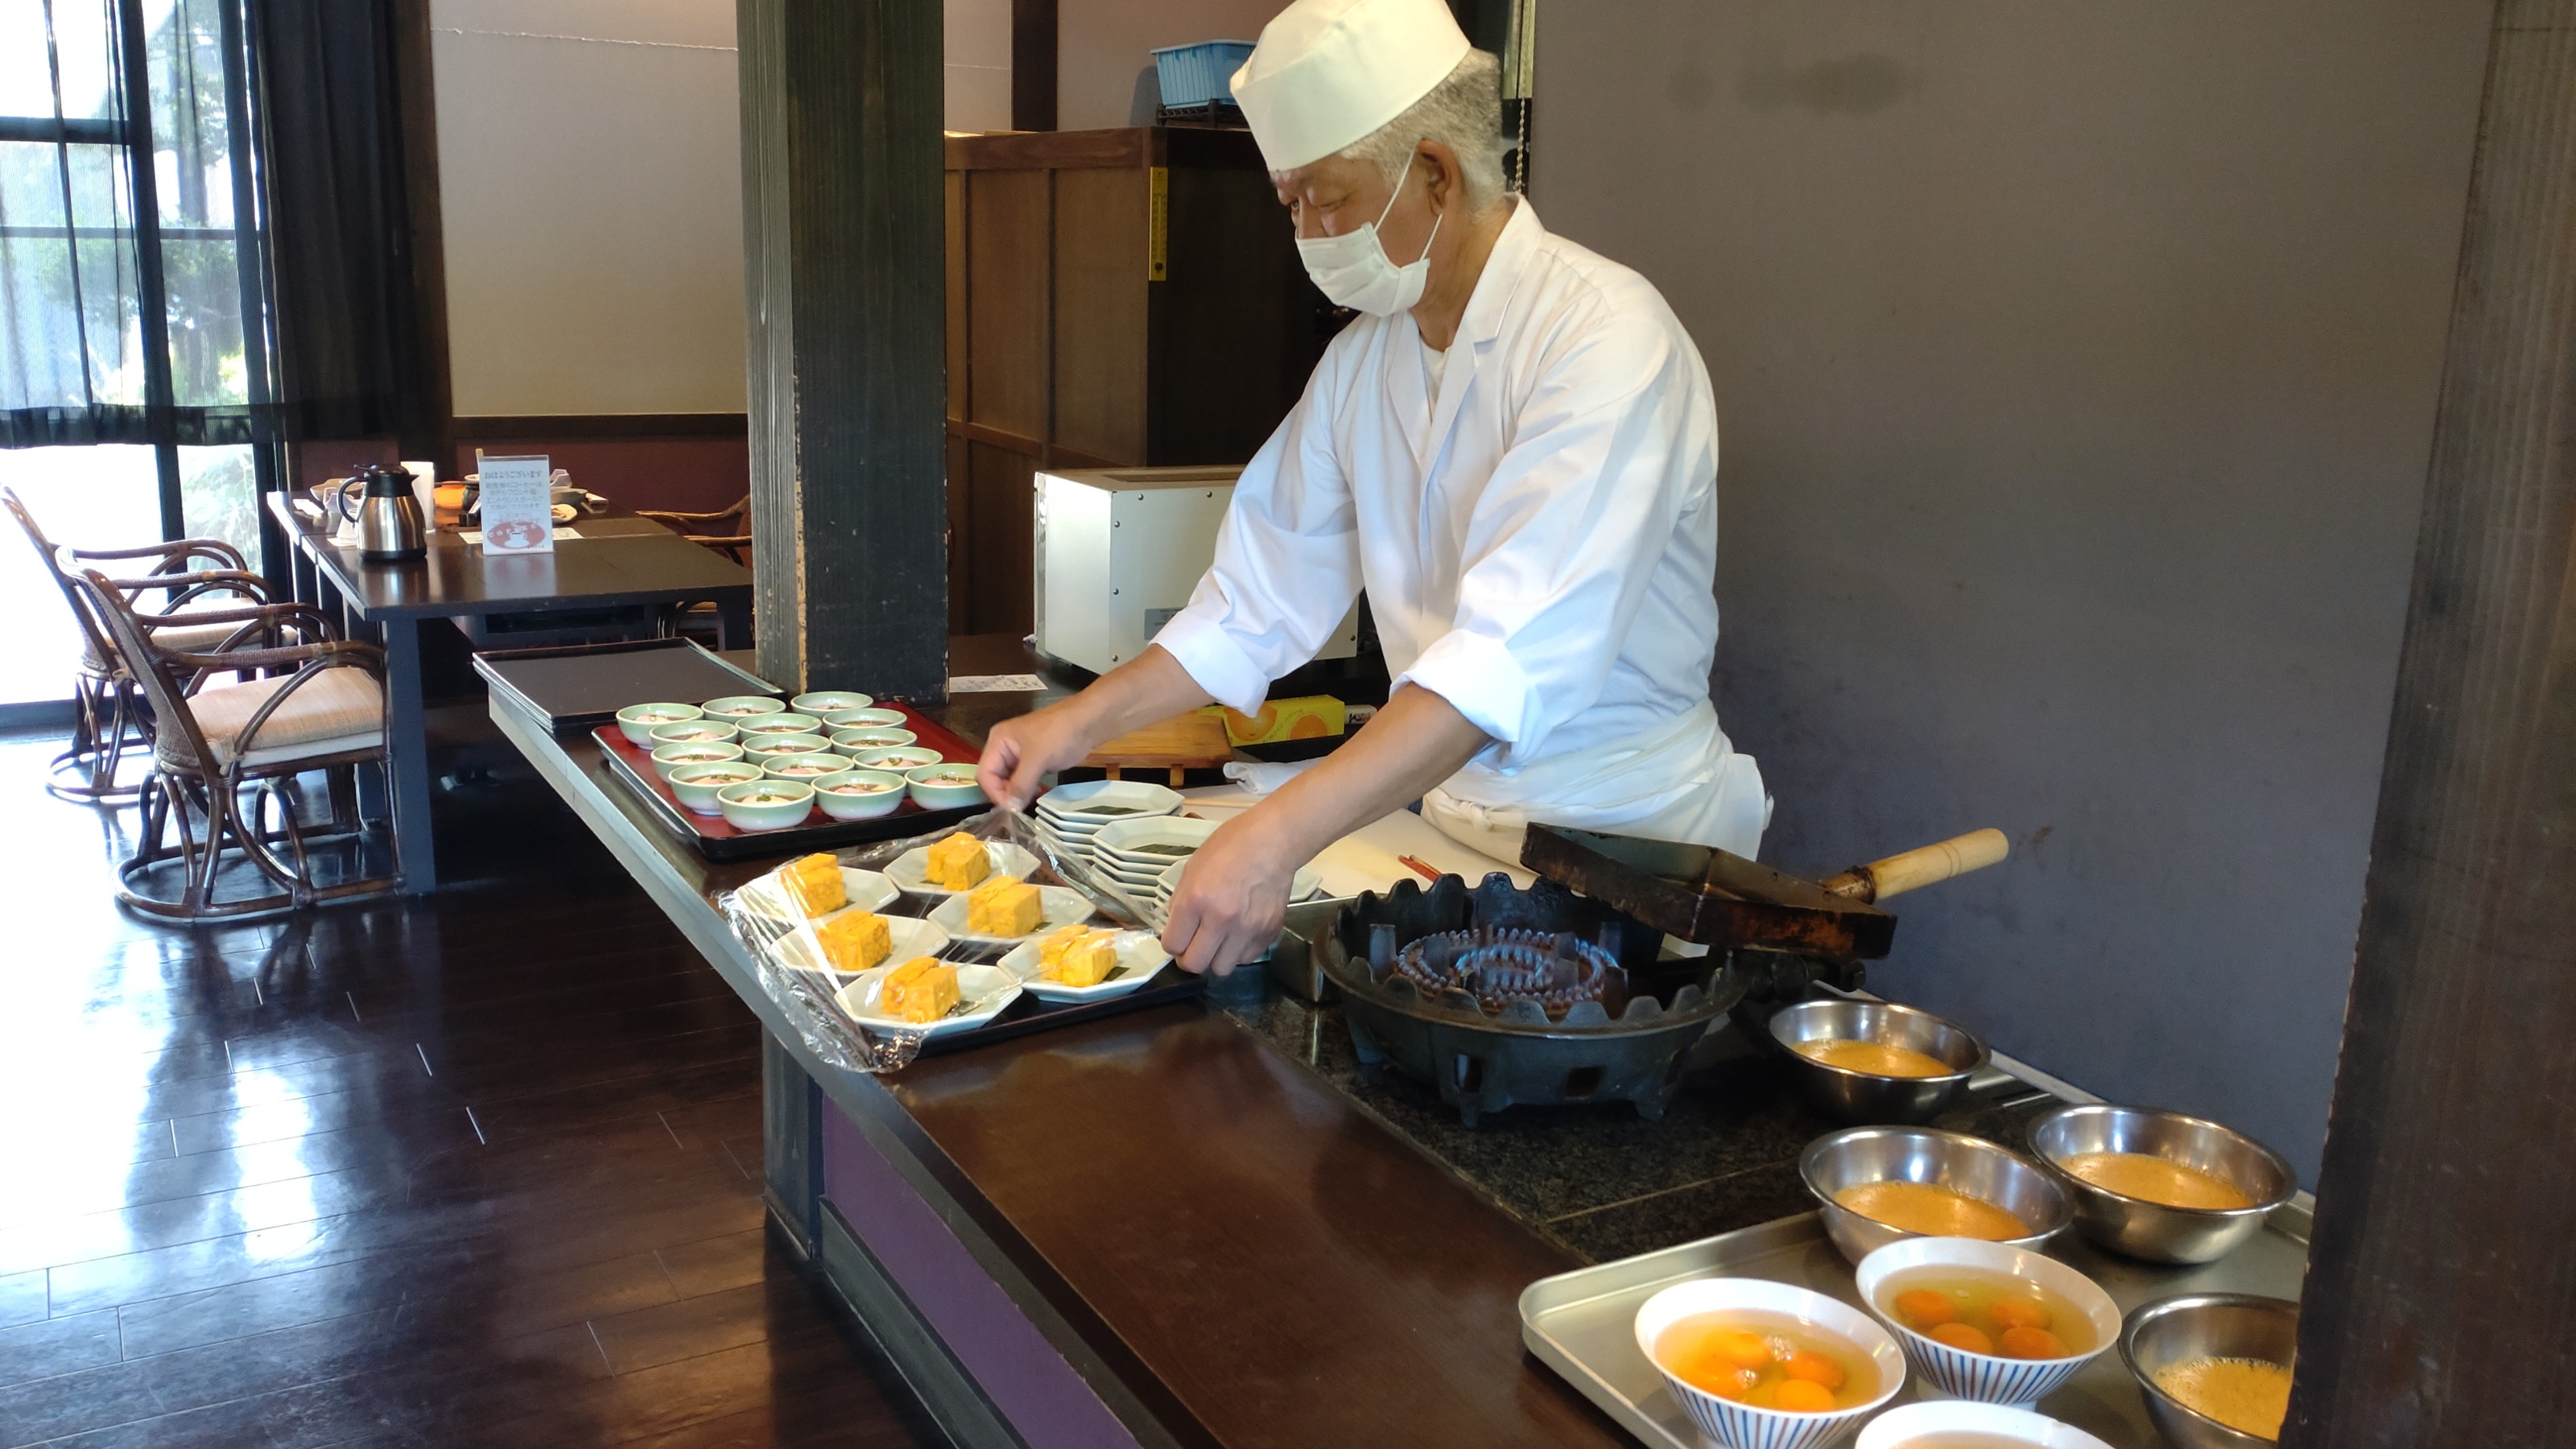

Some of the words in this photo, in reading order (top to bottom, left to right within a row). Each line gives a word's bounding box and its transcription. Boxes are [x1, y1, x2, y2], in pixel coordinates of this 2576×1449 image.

[485, 470, 543, 479] おはようございます
